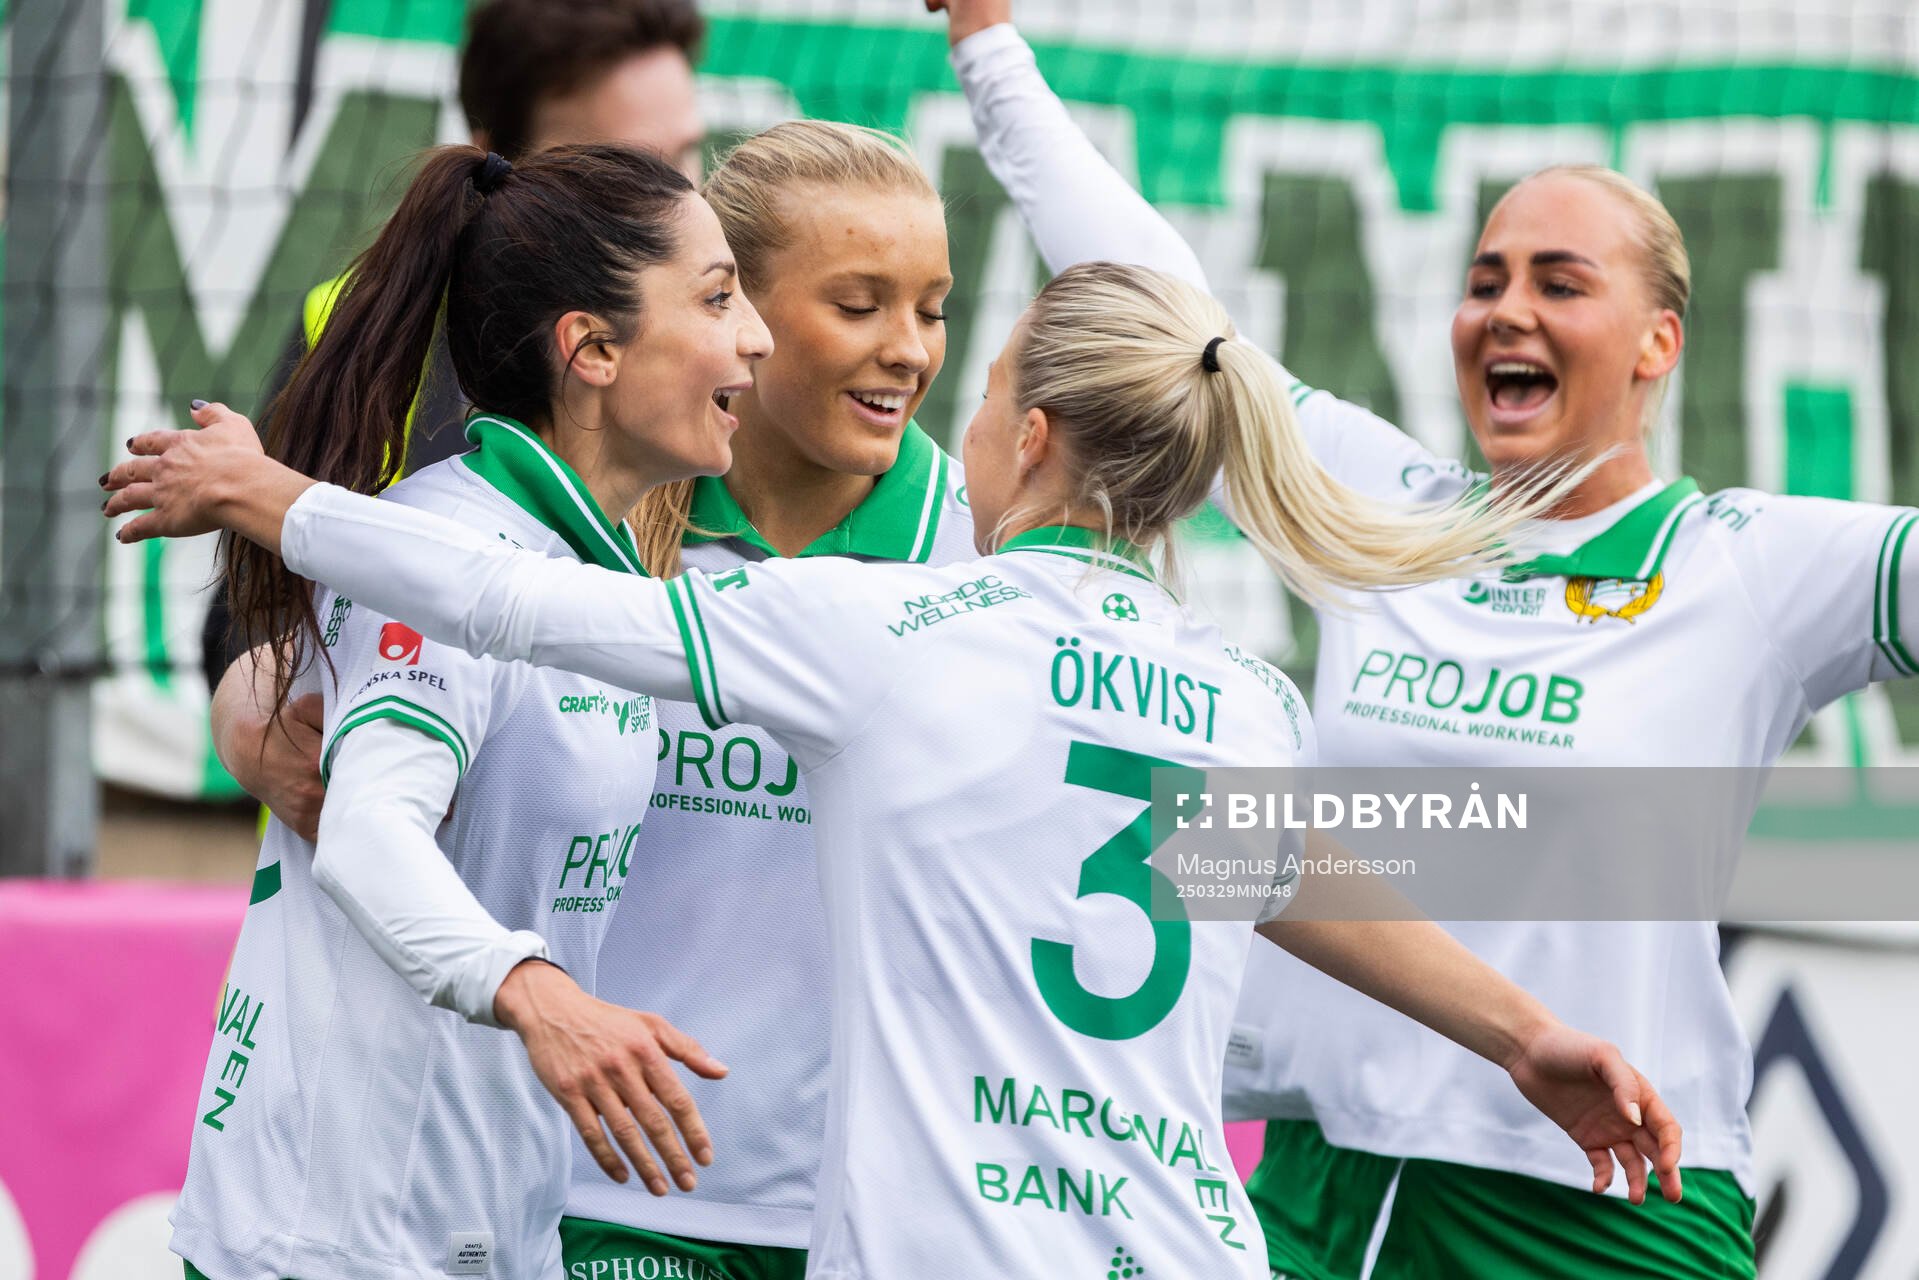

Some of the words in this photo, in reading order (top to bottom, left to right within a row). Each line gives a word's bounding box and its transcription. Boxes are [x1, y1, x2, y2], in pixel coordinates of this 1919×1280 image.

[887, 585, 1033, 638] WELLNESS
[903, 574, 1003, 616] NORDIC
[1491, 587, 1547, 603] INTER
[407, 670, 447, 692] SPEL
[1051, 636, 1222, 744] ÖKVIST
[1352, 649, 1585, 725] PROJOB
[559, 695, 600, 713] CRAFT
[630, 695, 650, 715] INTER
[631, 710, 651, 734] SPORT
[1344, 700, 1461, 735] PROFESSIONAL
[1467, 722, 1576, 749] WORKWEAR
[1031, 741, 1207, 1041] 3
[976, 1162, 1135, 1221] BANK
[563, 1255, 724, 1280] SPHORUS
